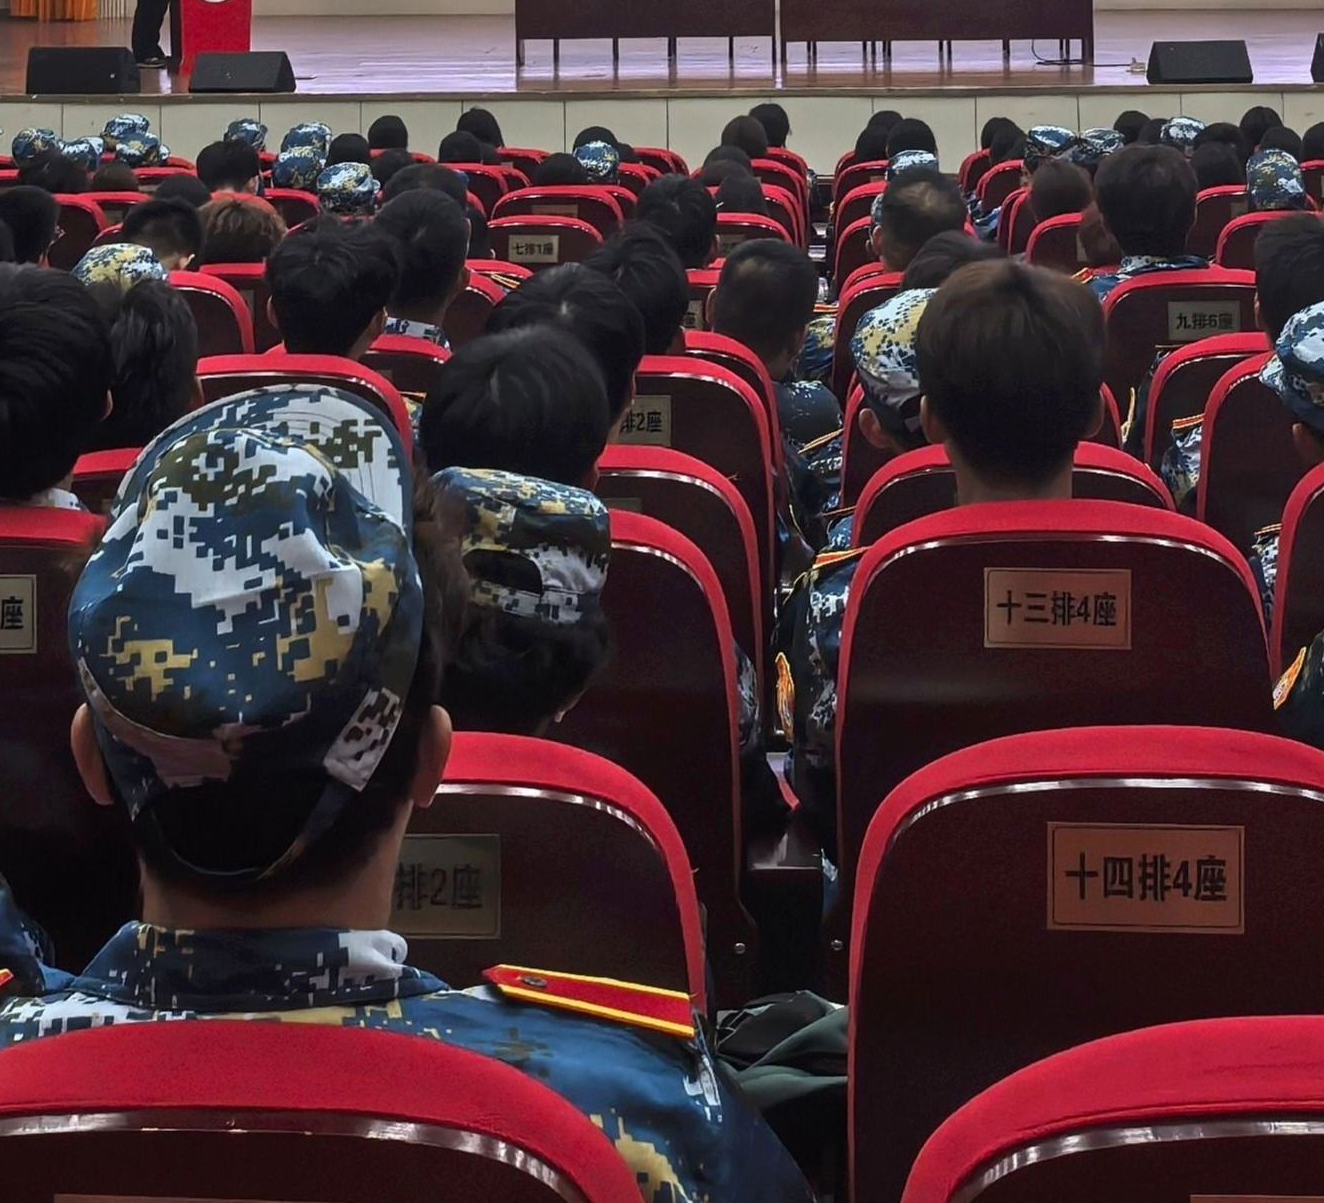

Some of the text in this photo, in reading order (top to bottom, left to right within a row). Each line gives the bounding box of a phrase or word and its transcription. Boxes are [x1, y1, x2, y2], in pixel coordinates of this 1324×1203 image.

[620, 410, 662, 434] 排2座
[995, 589, 1118, 627] 十三排4座
[395, 860, 484, 912] 排2座
[1064, 851, 1228, 903] 十四排4座
